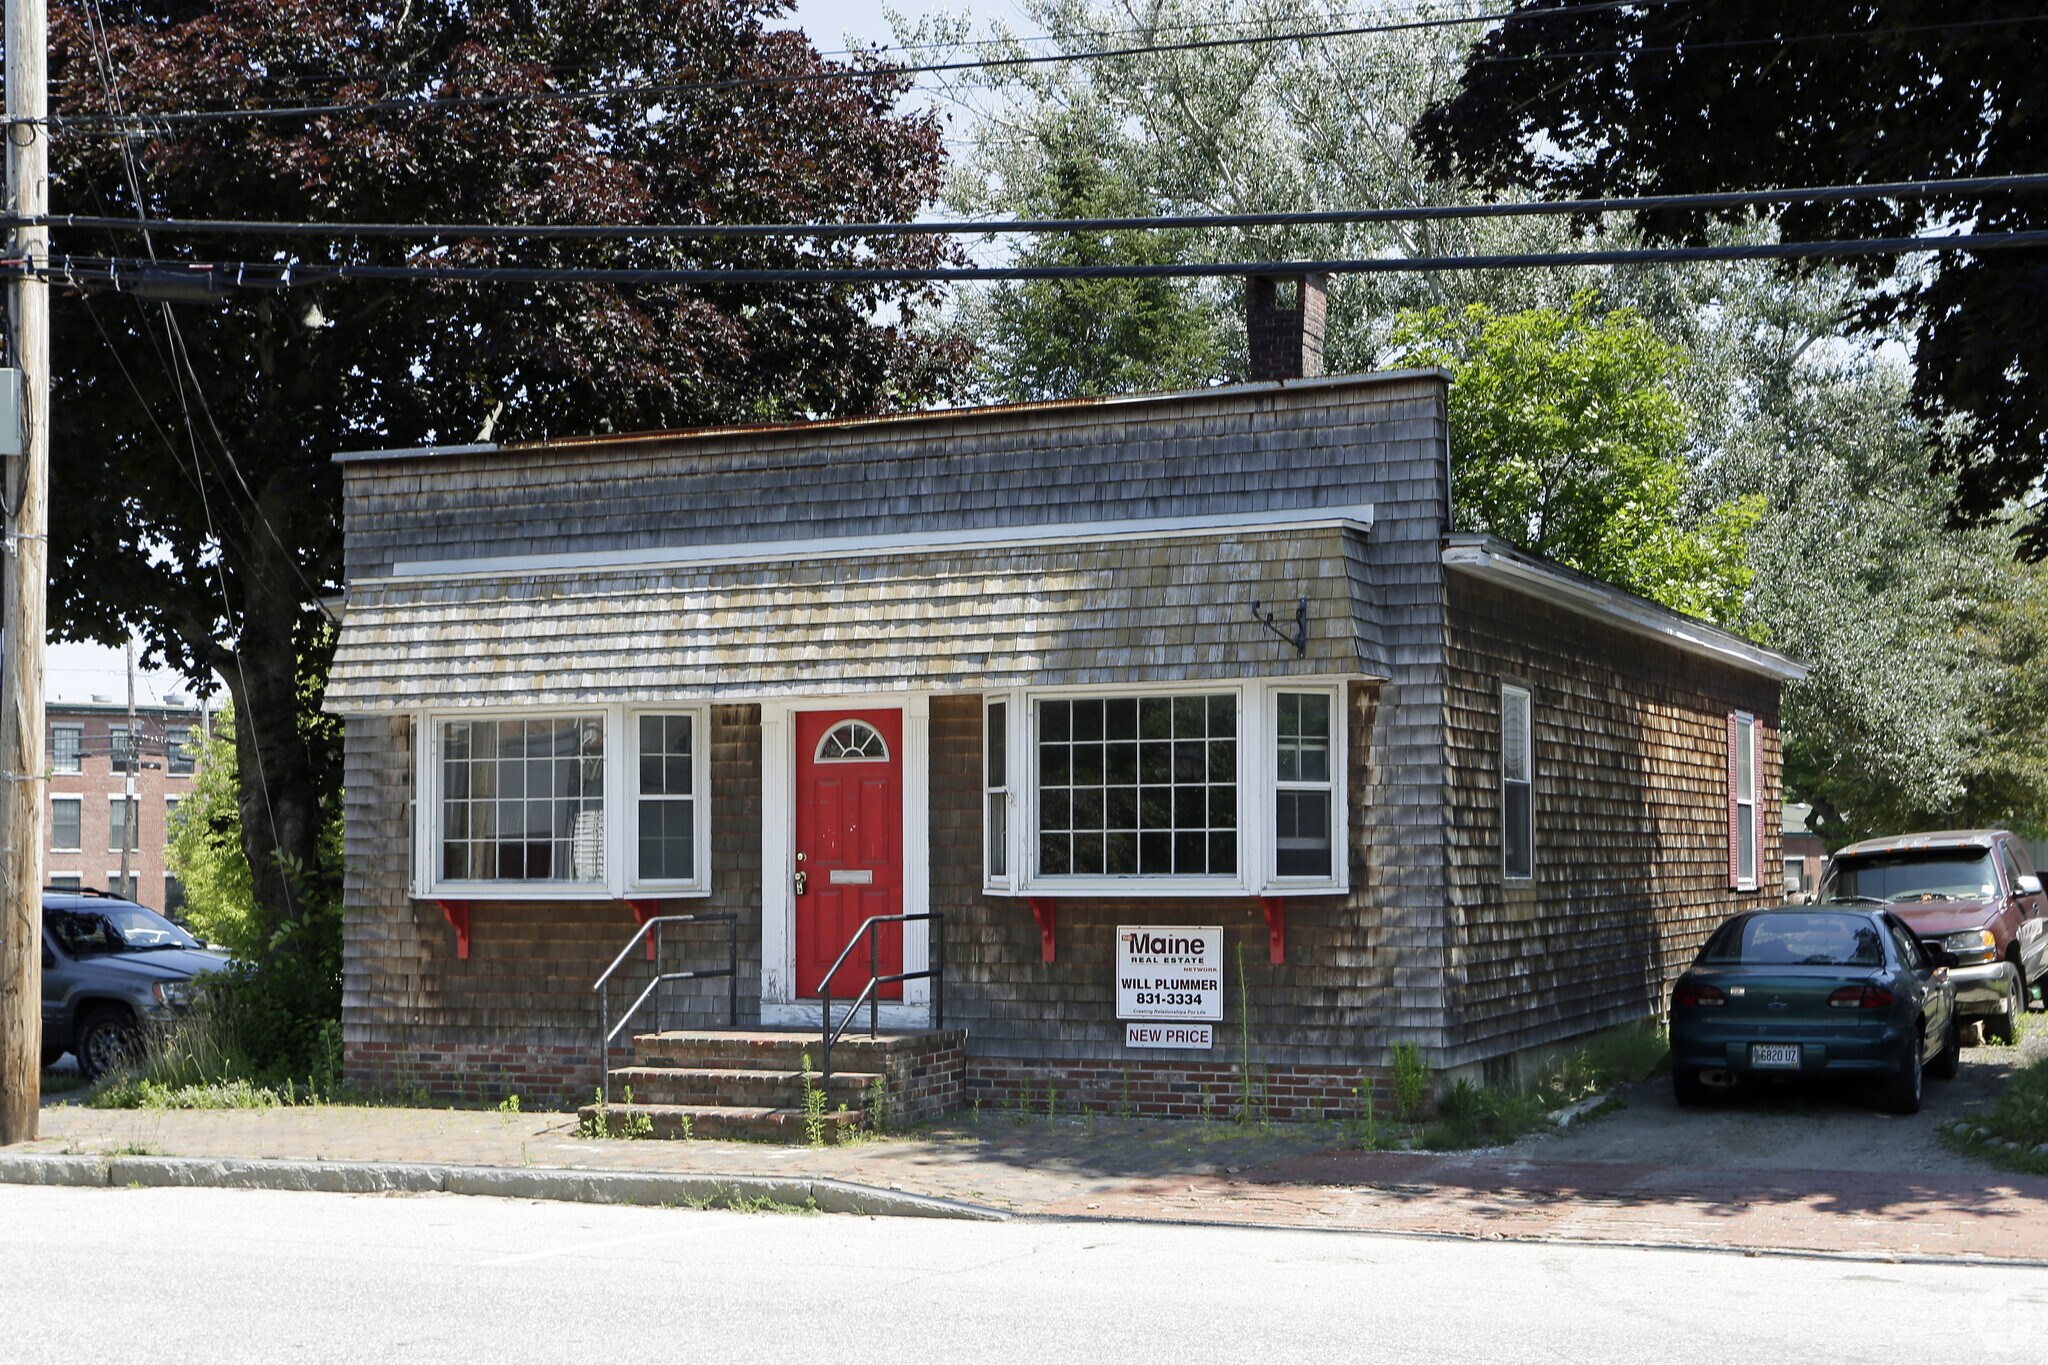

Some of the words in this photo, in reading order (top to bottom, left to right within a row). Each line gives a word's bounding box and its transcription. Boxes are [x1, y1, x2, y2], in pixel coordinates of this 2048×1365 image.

[1129, 933, 1205, 954] Maine
[1121, 978, 1151, 989] WILL
[1155, 979, 1218, 990] PLUMMER
[1136, 993, 1202, 1005] 831-3334
[1129, 1029, 1161, 1042] NEW
[1166, 1030, 1209, 1043] PRICE
[1761, 1050, 1783, 1061] 6820
